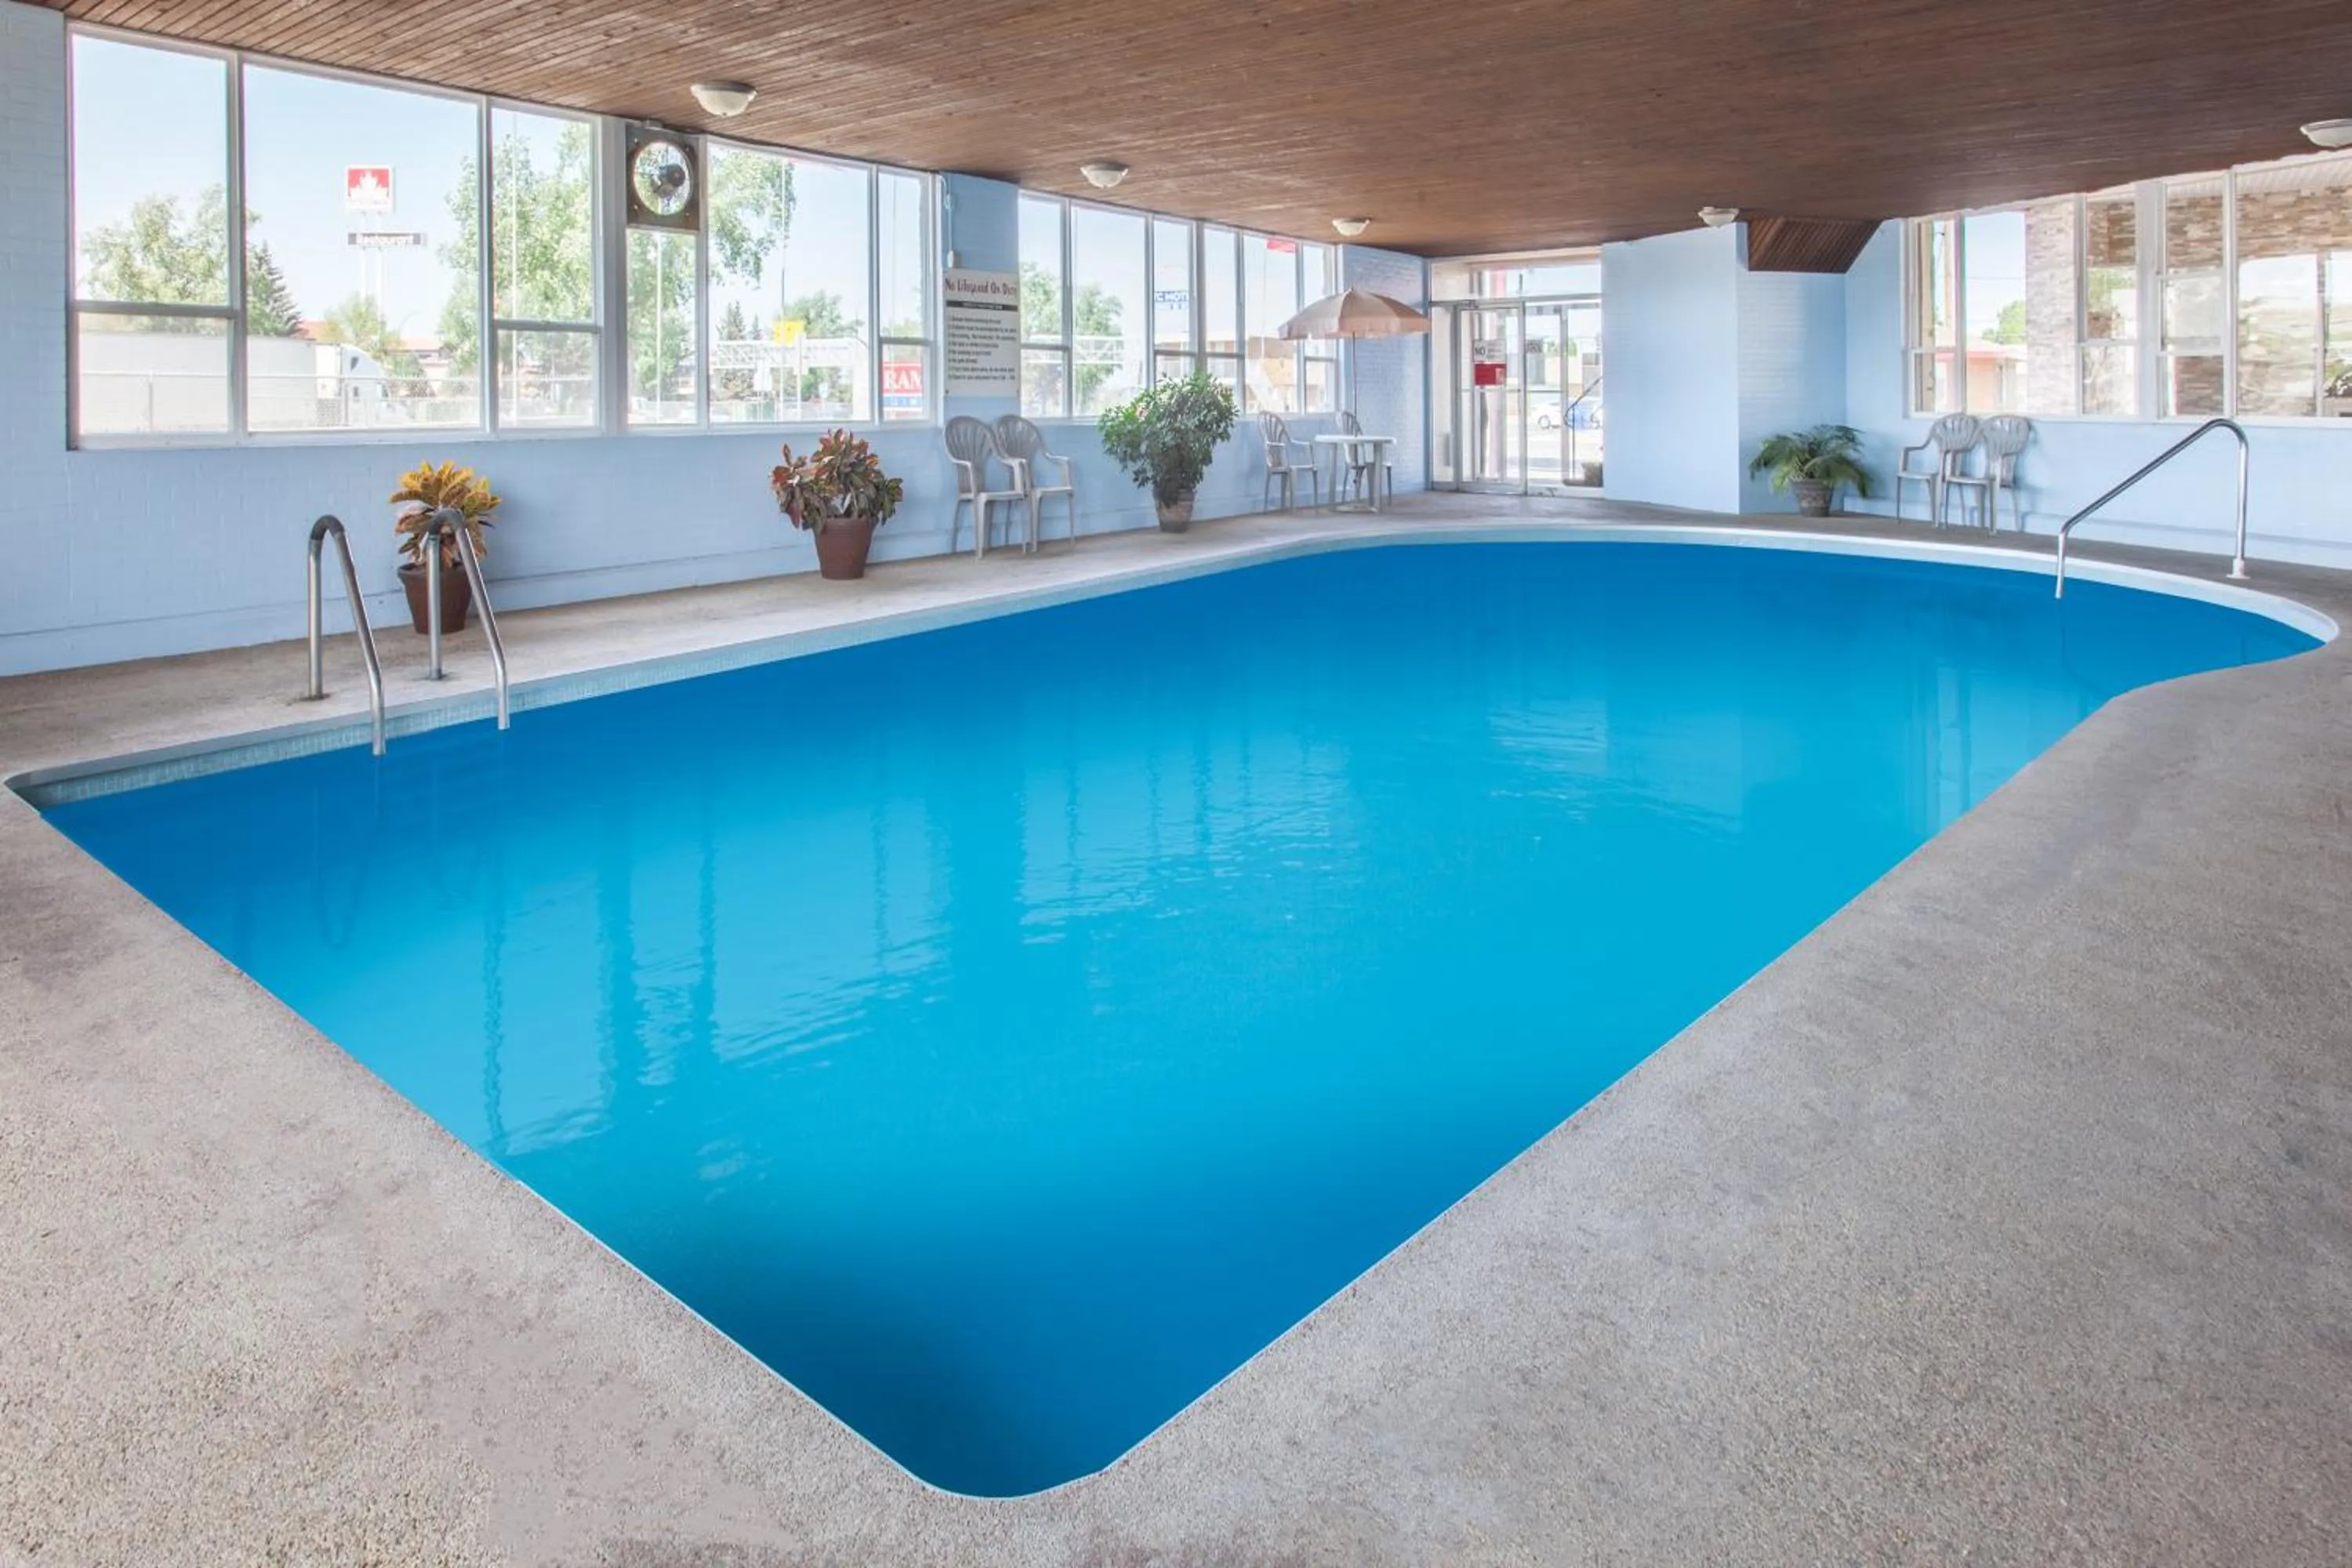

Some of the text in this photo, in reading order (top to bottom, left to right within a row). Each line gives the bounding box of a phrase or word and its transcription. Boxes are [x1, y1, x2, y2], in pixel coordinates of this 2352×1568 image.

[945, 278, 956, 292] No
[957, 278, 989, 295] Lifeguard
[990, 281, 1001, 295] On
